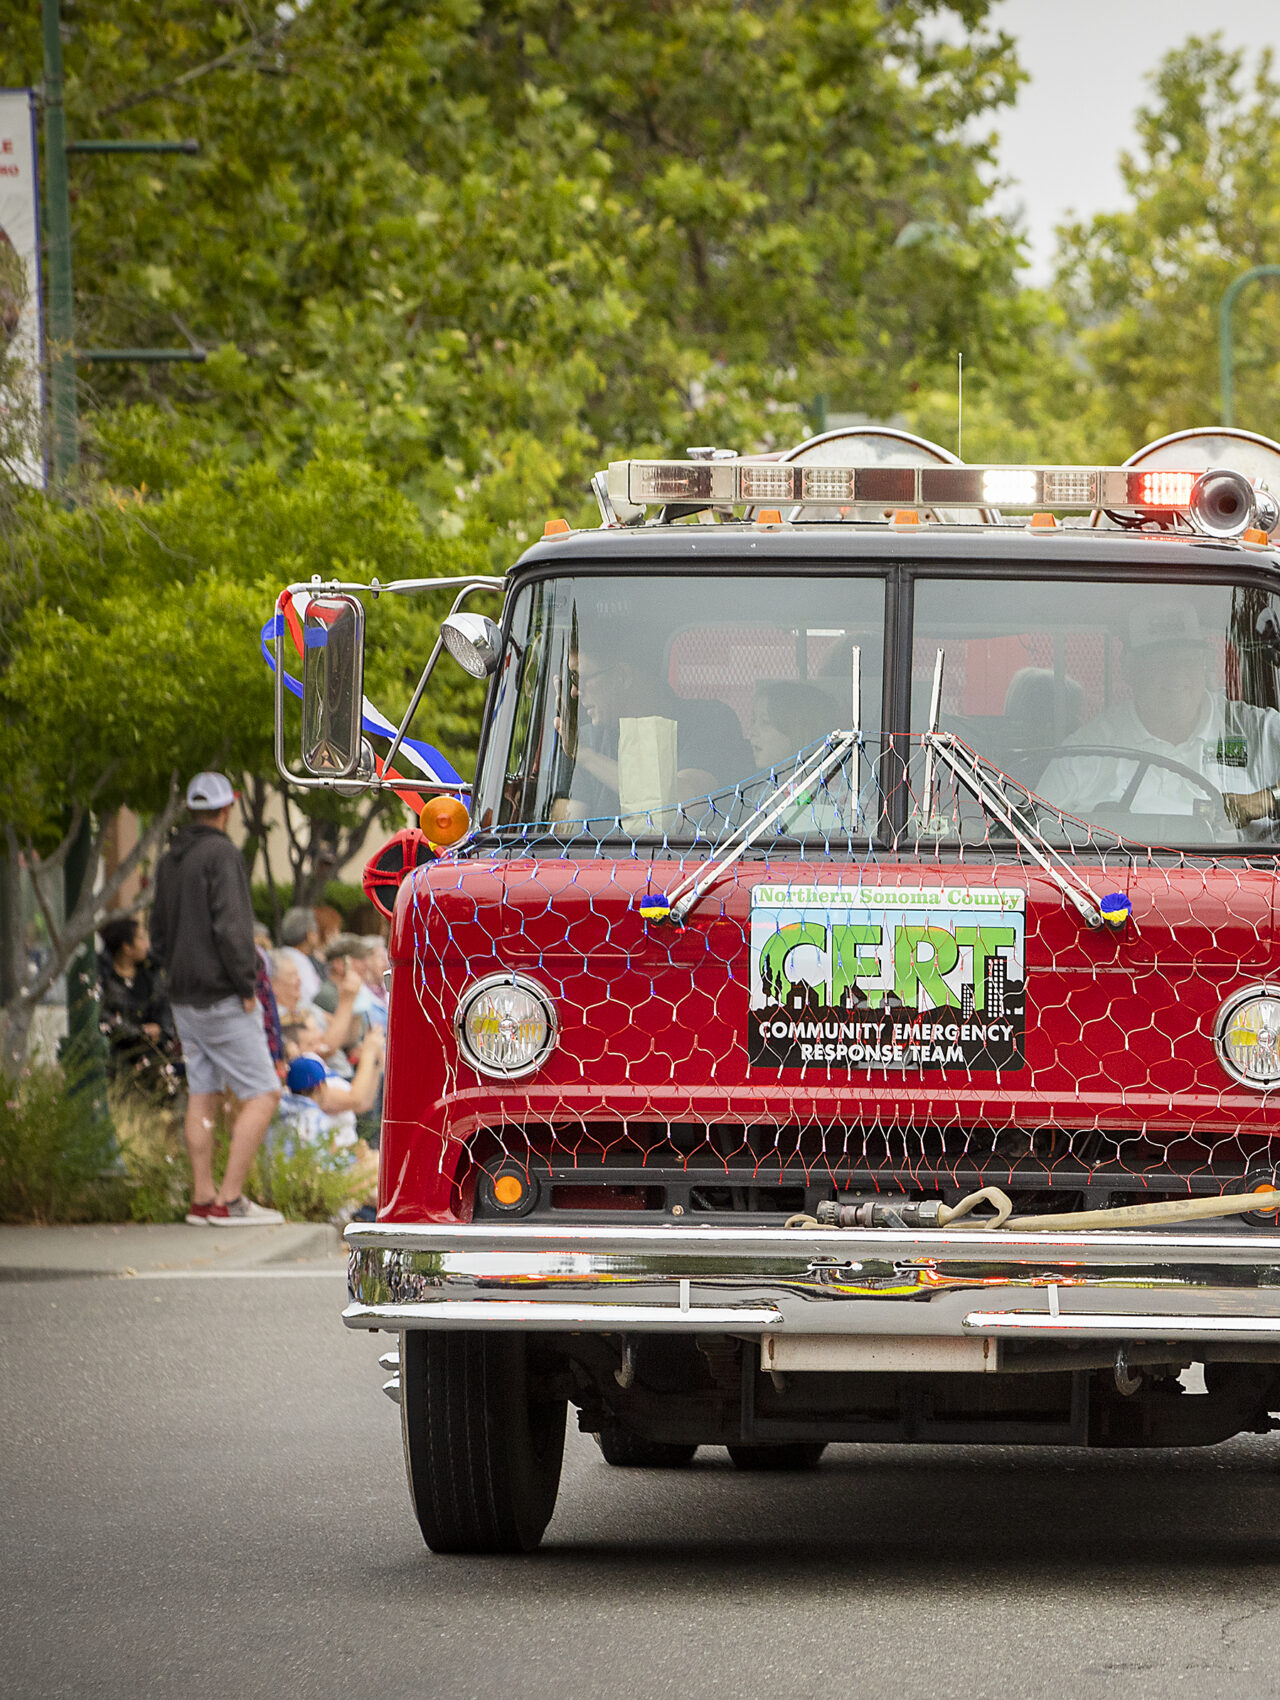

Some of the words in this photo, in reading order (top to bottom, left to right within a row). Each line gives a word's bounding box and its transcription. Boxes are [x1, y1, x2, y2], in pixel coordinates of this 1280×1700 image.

[758, 887, 852, 904] Northern
[860, 888, 941, 905] Sonoma
[948, 889, 1020, 909] County
[759, 921, 1016, 1012] CERT
[758, 1021, 886, 1041] COMMUNITY
[893, 1022, 1014, 1042] EMERGENCY
[800, 1043, 903, 1062] RESPONSE
[909, 1045, 965, 1063] TEAM
